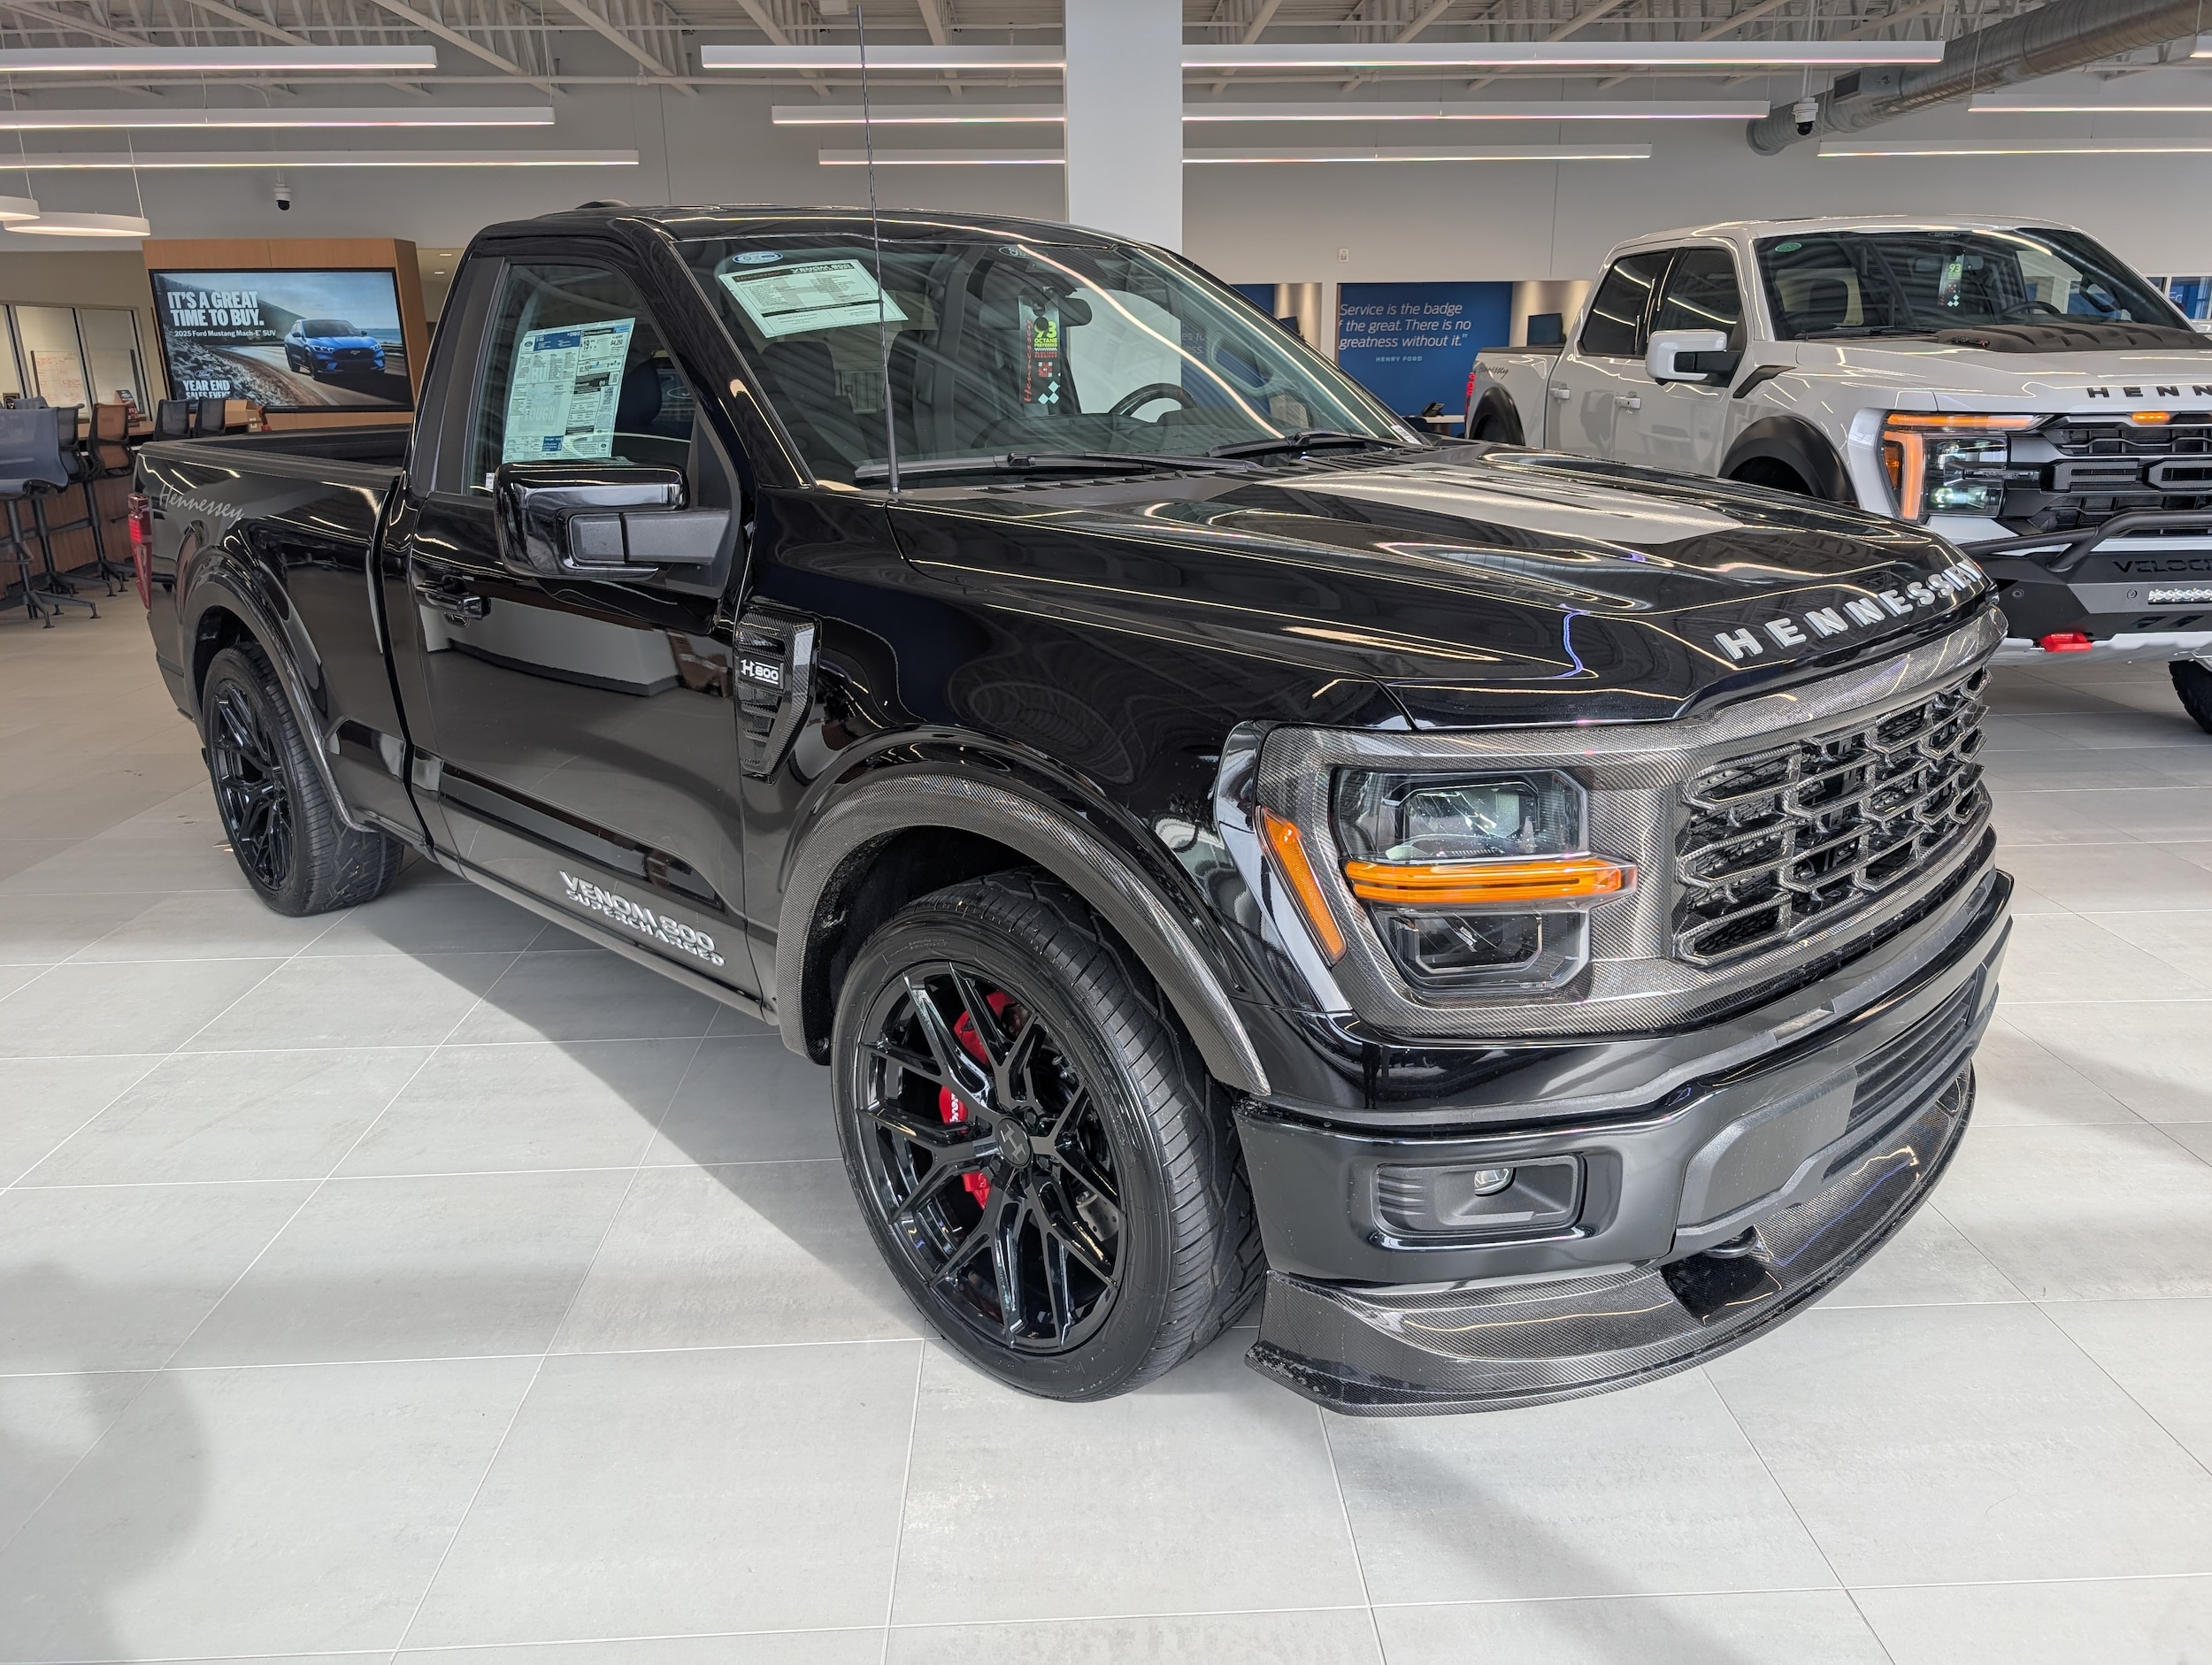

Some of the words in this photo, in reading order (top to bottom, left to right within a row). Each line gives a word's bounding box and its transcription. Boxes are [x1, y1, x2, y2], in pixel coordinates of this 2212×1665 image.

[1949, 264, 1962, 272] 93
[167, 291, 196, 309] IT'S
[199, 291, 211, 309] A
[211, 291, 258, 309] GREAT
[170, 310, 208, 326] TIME
[209, 309, 229, 326] TO
[230, 309, 265, 326] BUY.
[1340, 303, 1384, 316] Service
[1387, 303, 1397, 315] is
[1401, 303, 1420, 315] the
[1424, 302, 1463, 317] badge
[1346, 319, 1366, 332] the
[1368, 320, 1402, 334] great.
[1405, 319, 1439, 331] There
[1442, 319, 1452, 331] is
[1455, 320, 1471, 331] no
[1339, 336, 1398, 350] greatness
[1402, 335, 1448, 348] without
[182, 380, 209, 391] YEAR
[210, 380, 230, 391] END
[159, 484, 245, 529] Hennessey
[559, 870, 658, 928] VENOM
[659, 915, 716, 952] 800
[566, 888, 726, 967] SUPERCHARGED
